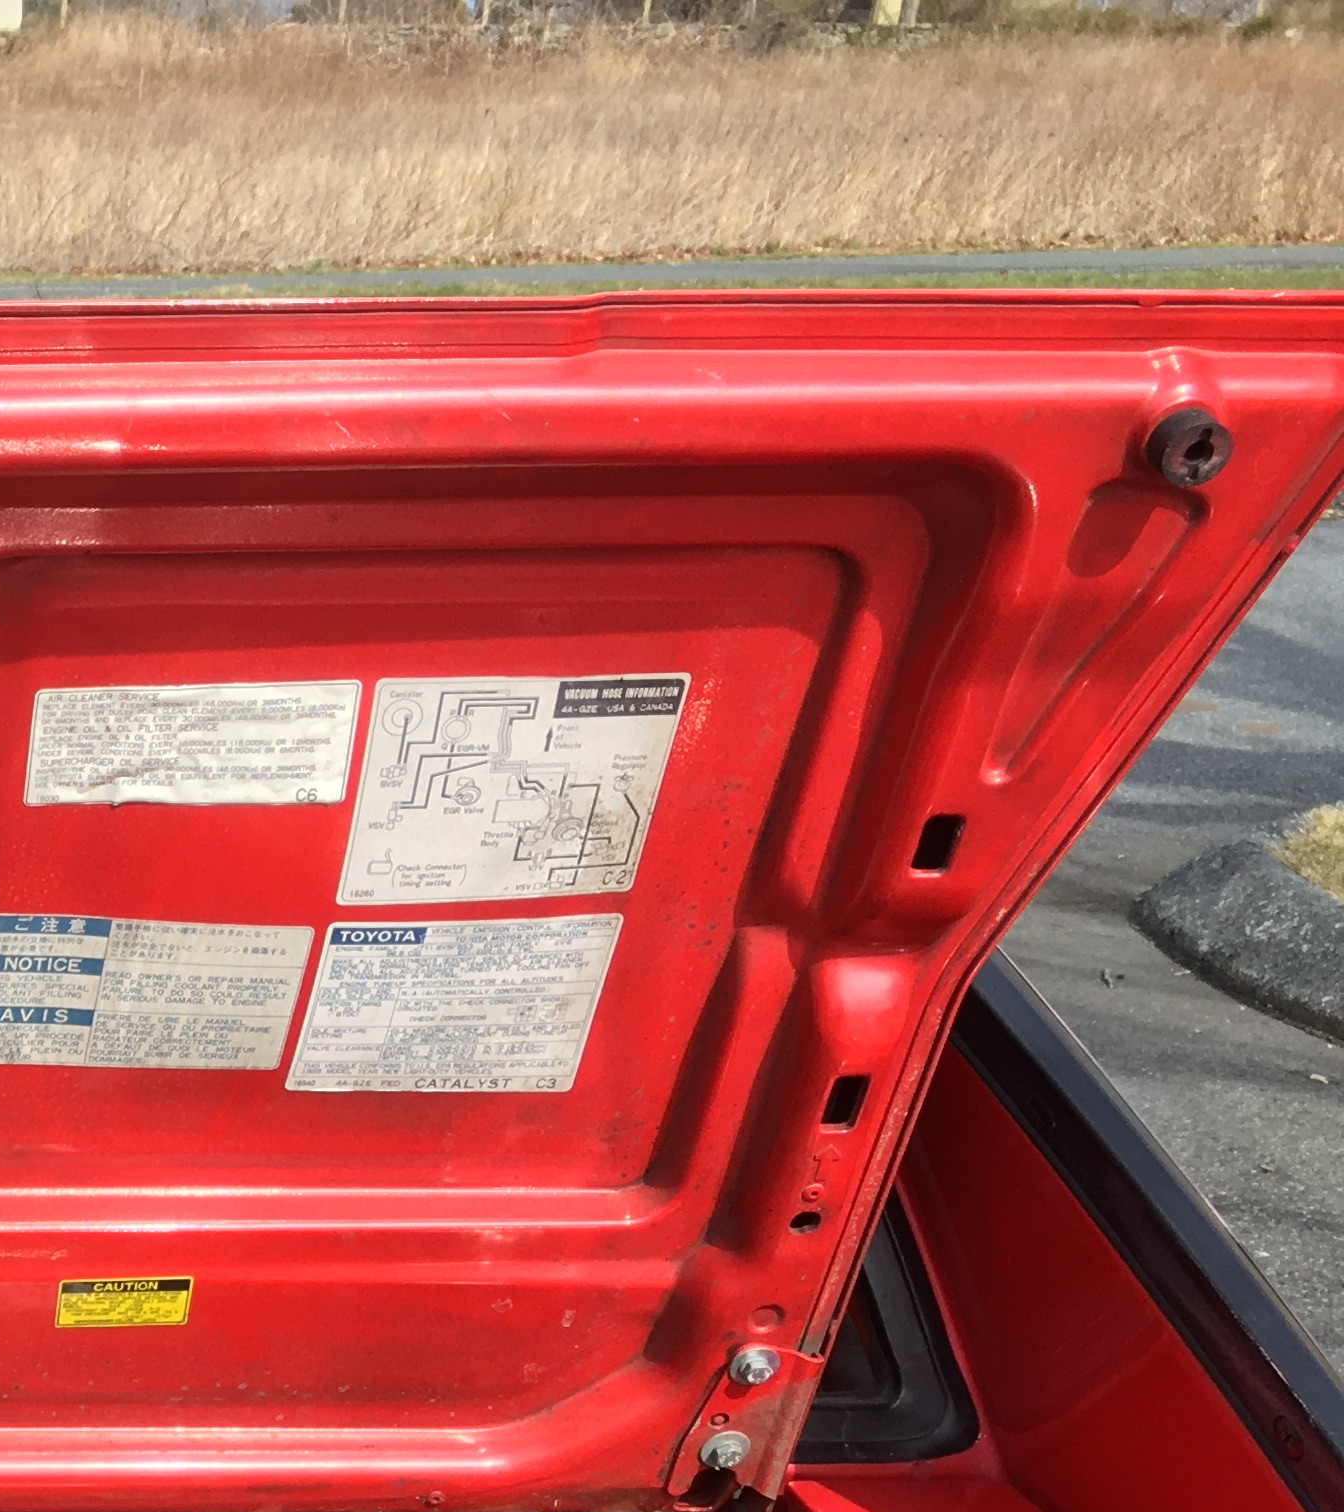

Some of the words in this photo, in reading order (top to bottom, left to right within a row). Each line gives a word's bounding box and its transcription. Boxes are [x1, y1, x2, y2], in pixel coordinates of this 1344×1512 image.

[68, 693, 113, 702] CLEANER
[119, 693, 160, 701] SERVICE
[390, 690, 423, 698] Canister
[564, 688, 599, 700] VACUUM
[601, 688, 623, 699] HOSE
[625, 686, 680, 699] INFORMATION
[606, 704, 625, 712] USA
[639, 703, 674, 711] CANADA
[43, 726, 78, 734] ENGINE
[83, 725, 98, 733] OIL
[117, 725, 132, 733] OIL
[138, 723, 172, 733] FILTER
[178, 723, 219, 732] SERVICE
[40, 757, 114, 767] SUPERCHARGER
[120, 758, 134, 767] OIL
[141, 757, 180, 766] SERVICE
[295, 788, 318, 802] C6
[15, 917, 86, 933] ご注意
[340, 931, 415, 942] TOYOTA
[3, 957, 83, 973] NOTICE
[104, 971, 132, 979] READ
[207, 976, 244, 984] REPAIR
[249, 977, 290, 986] MANUAL
[44, 983, 90, 992] SPECIAL
[130, 980, 168, 988] FILLING
[174, 982, 221, 990] COOLANT
[39, 991, 82, 999] FILLING
[103, 987, 143, 995] FAILURE
[172, 989, 184, 997] DO
[210, 991, 243, 999] COULD
[248, 992, 288, 1000] RESULT
[117, 995, 158, 1003] SERIOUS
[164, 996, 205, 1005] DAMAGE
[212, 998, 225, 1006] TO
[0, 1008, 69, 1022] AVIS
[205, 1018, 246, 1026] MANUEL
[93, 1035, 148, 1043] RADIATEUR
[414, 1078, 512, 1090] CATALYST
[535, 1078, 558, 1089] C3
[93, 1281, 159, 1292] CAUTION
